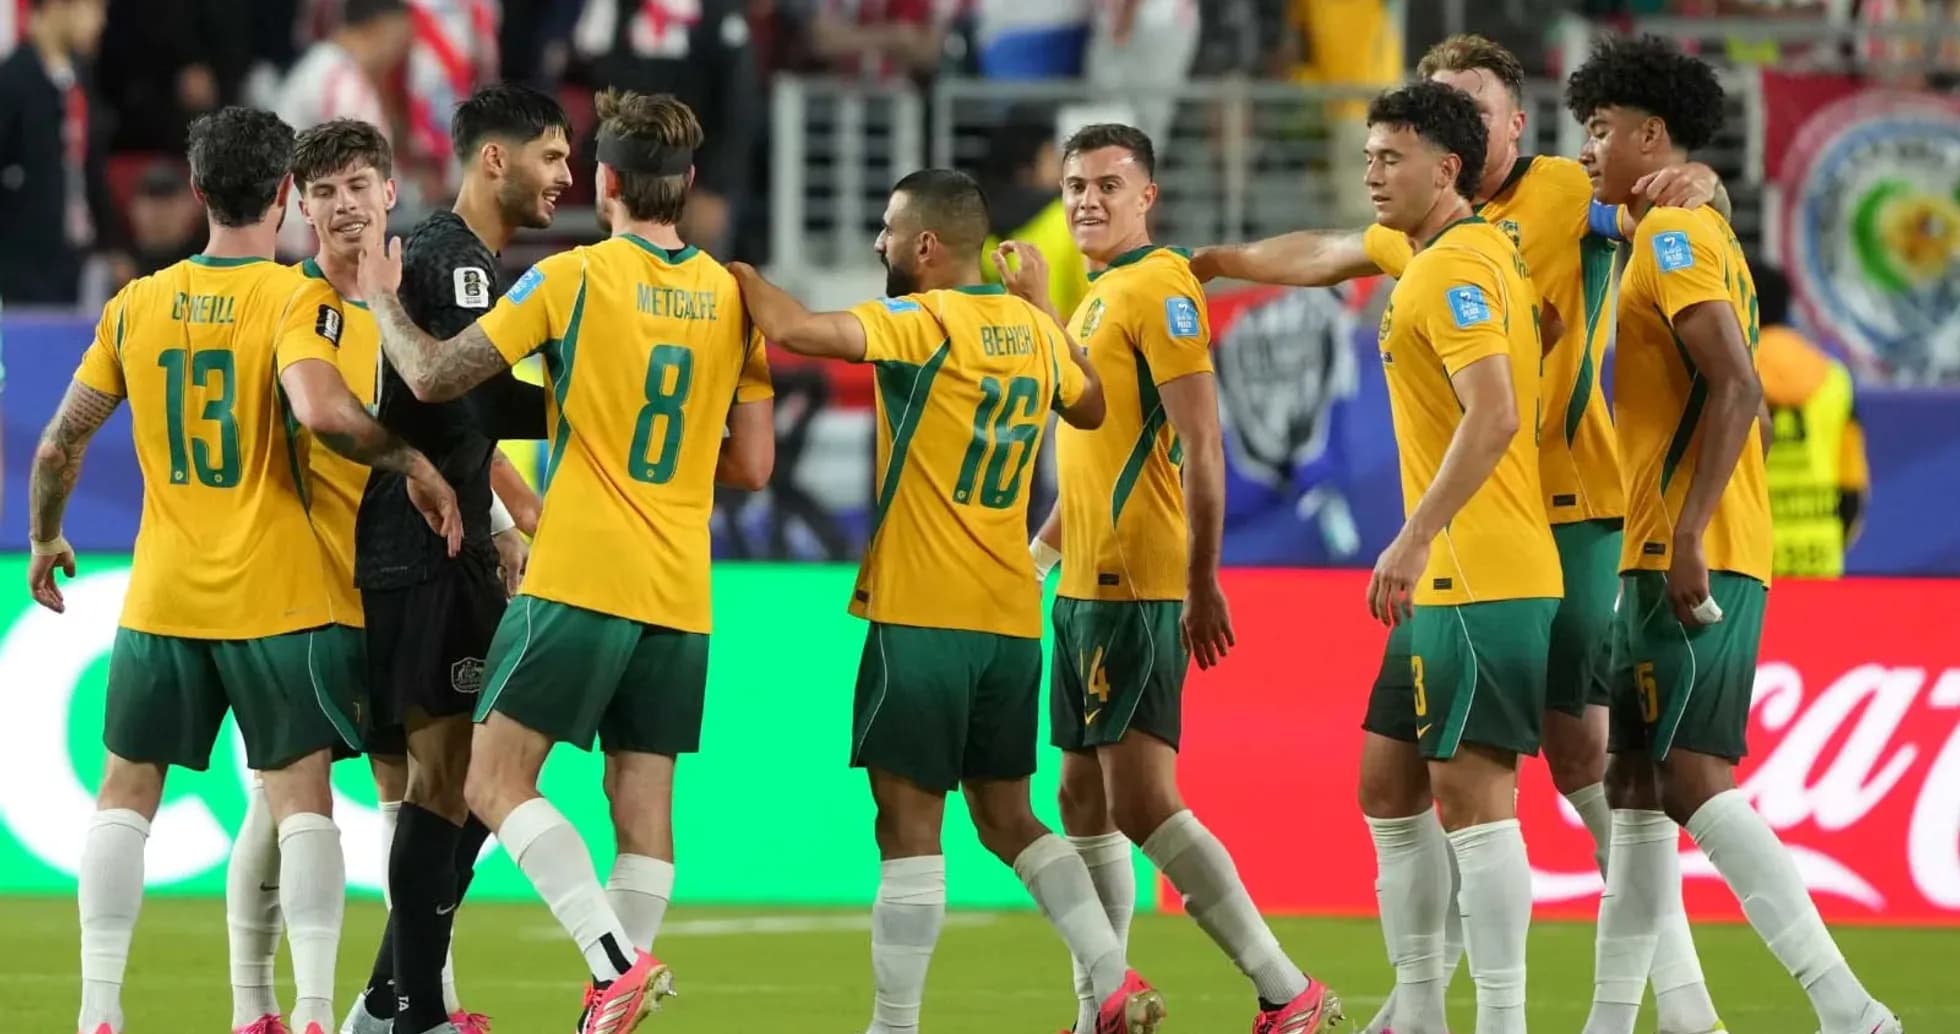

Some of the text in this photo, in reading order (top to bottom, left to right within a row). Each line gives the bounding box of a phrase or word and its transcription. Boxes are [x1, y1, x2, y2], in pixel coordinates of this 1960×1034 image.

[158, 348, 242, 488] 13
[628, 344, 694, 485] 8
[952, 376, 1040, 509] 16
